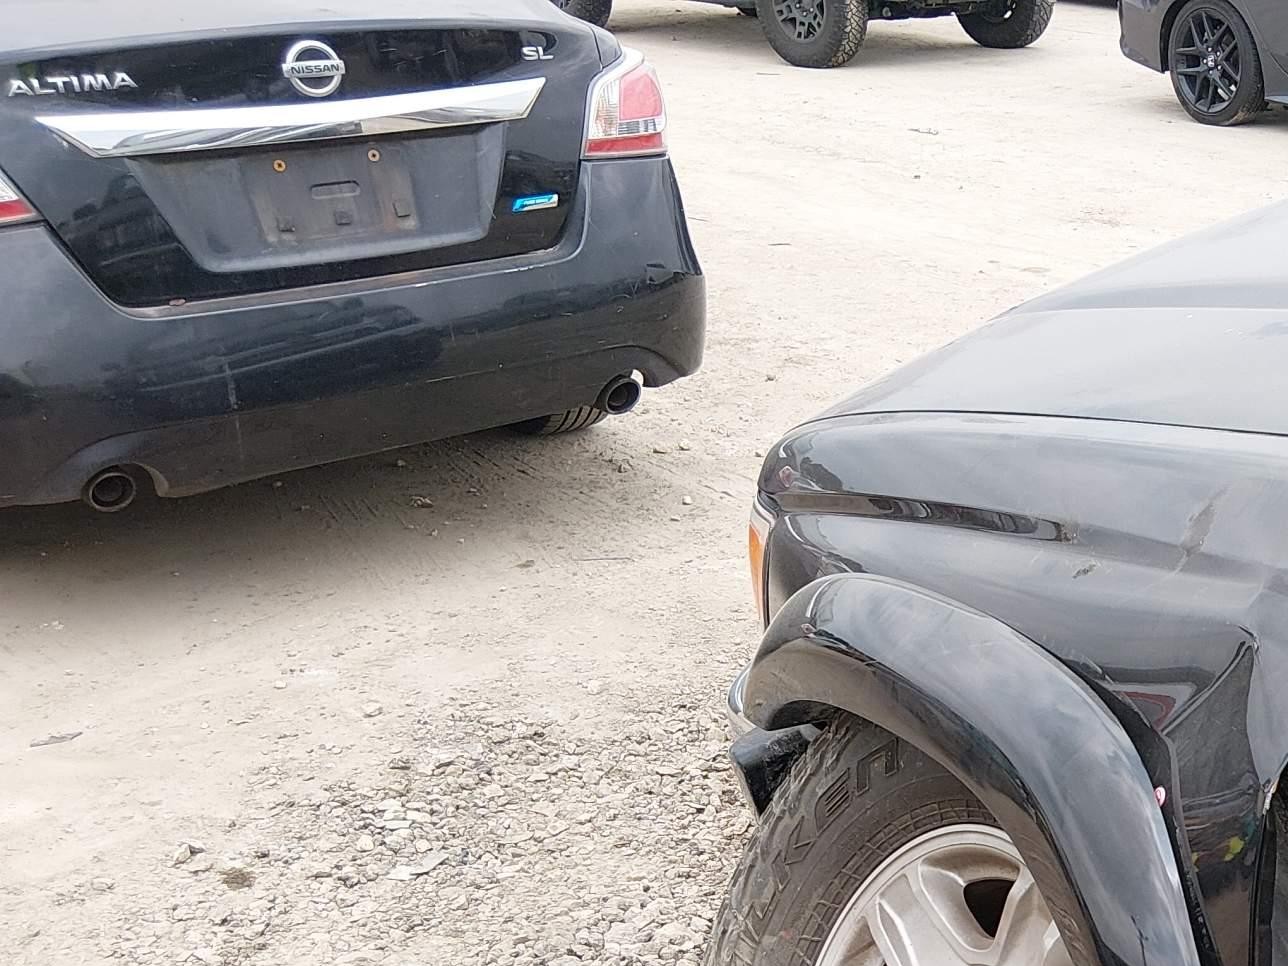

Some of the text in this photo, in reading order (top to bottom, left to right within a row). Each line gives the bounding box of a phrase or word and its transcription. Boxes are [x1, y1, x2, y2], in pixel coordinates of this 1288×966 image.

[522, 46, 554, 61] SL
[291, 64, 341, 76] NISSAN
[9, 72, 138, 96] ALTIMA
